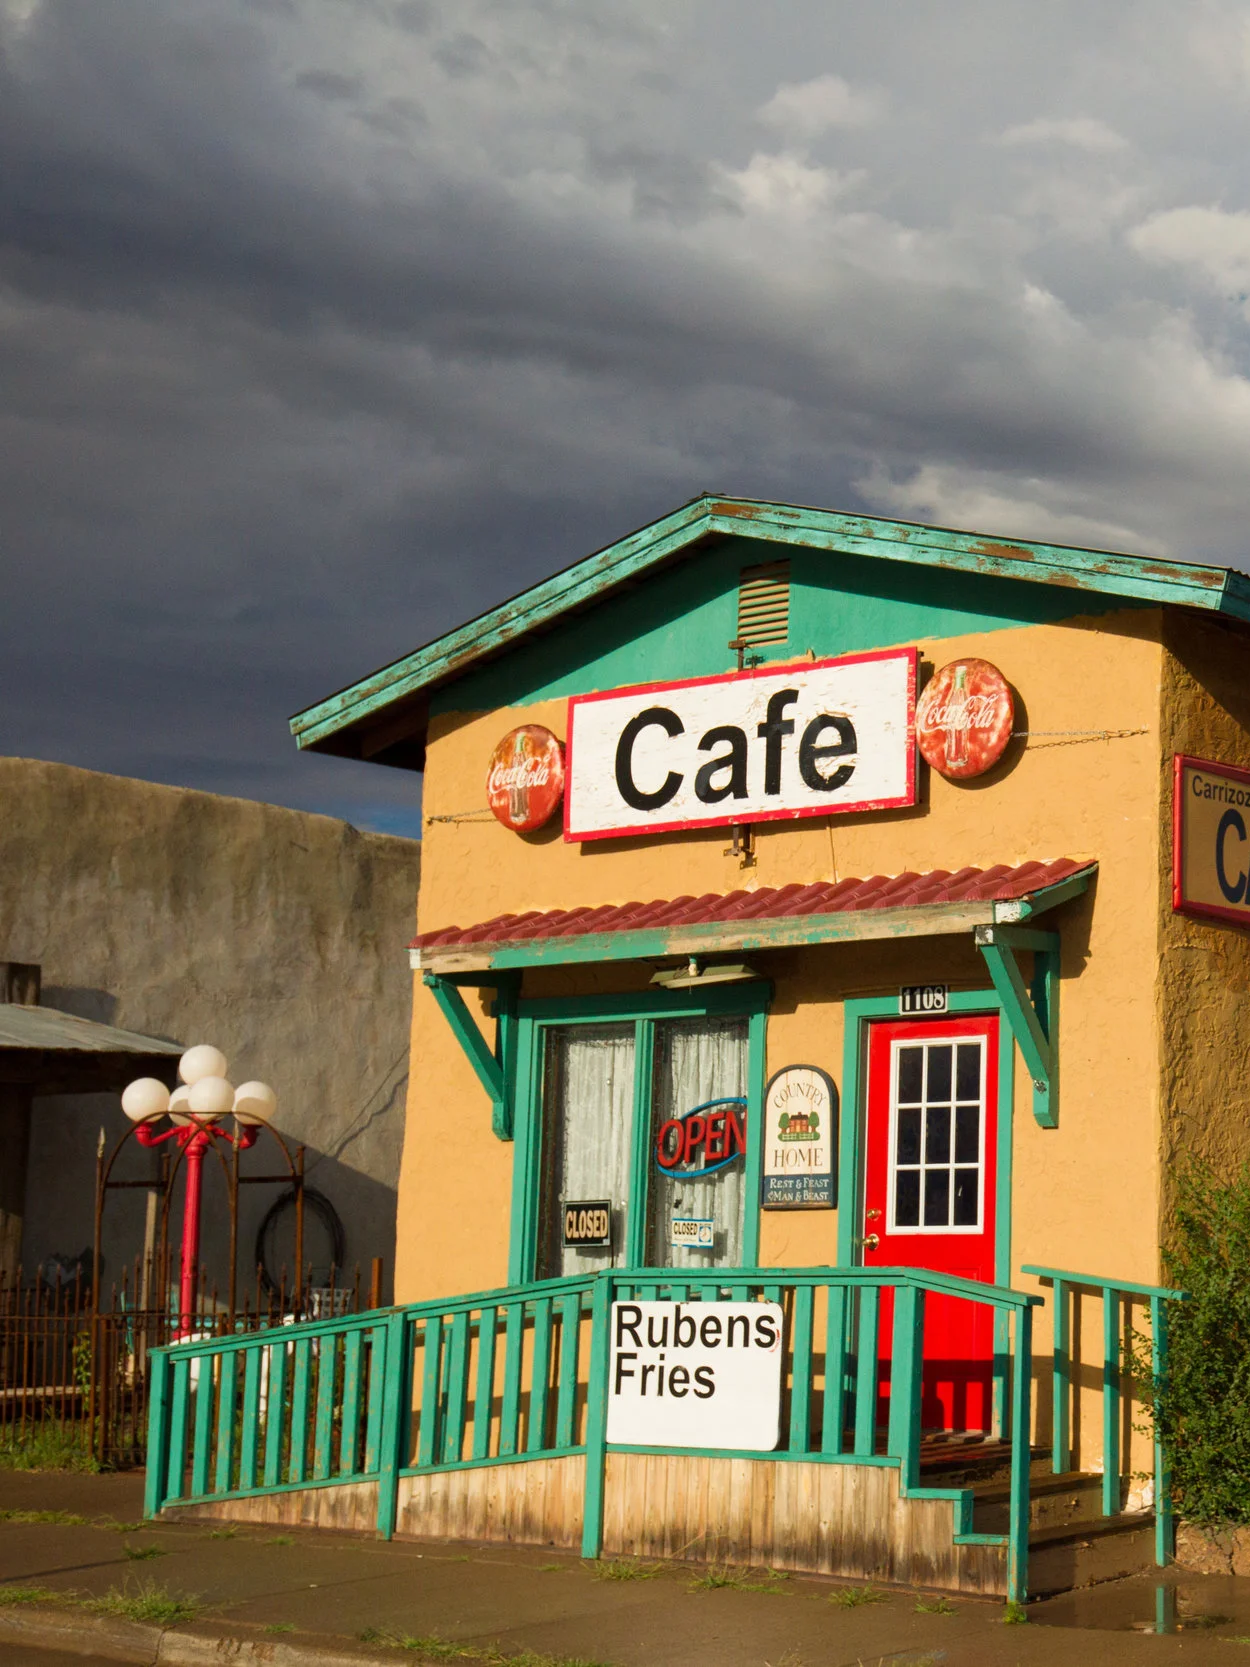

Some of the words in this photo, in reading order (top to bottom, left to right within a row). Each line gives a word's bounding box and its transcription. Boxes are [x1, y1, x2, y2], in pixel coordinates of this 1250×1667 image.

[614, 688, 858, 811] Cafe
[903, 986, 945, 1011] 1108
[774, 1083, 827, 1109] COUNTRY
[657, 1108, 748, 1167] OPEN
[773, 1147, 824, 1168] HOME
[795, 1179, 802, 1189] &
[566, 1209, 608, 1238] CLOSED
[674, 1222, 697, 1235] CLOSED
[616, 1305, 776, 1348] Rubens
[615, 1352, 715, 1398] Fries
